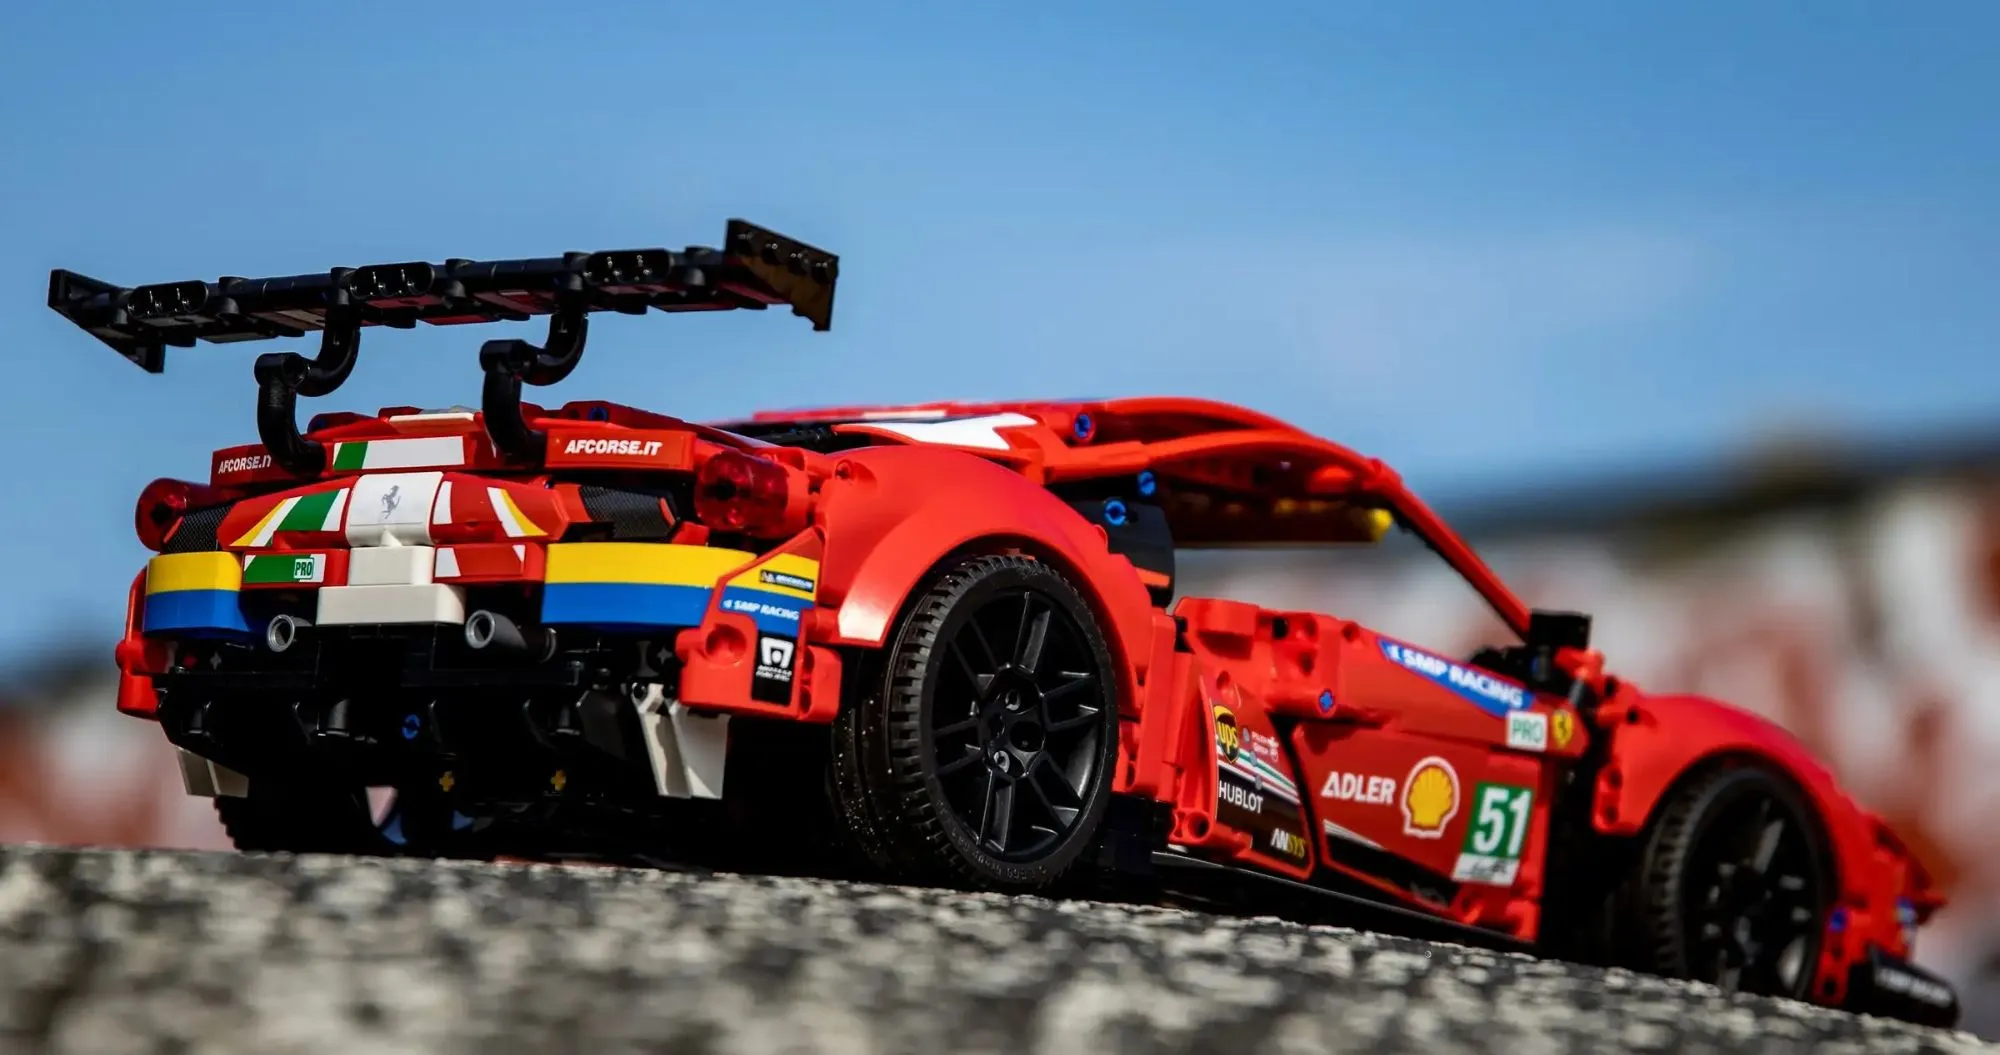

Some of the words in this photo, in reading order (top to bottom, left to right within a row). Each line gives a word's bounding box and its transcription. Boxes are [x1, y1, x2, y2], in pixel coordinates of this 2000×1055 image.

[563, 439, 663, 456] AFCORSE.IT
[294, 561, 313, 577] PRO
[760, 604, 800, 621] RACING
[1403, 648, 1449, 677] SMP
[1448, 663, 1524, 709] RACING
[1512, 718, 1544, 743] PRO
[1218, 780, 1263, 814] HUBLOT
[1320, 771, 1397, 805] ADLER
[1473, 786, 1533, 857] 51
